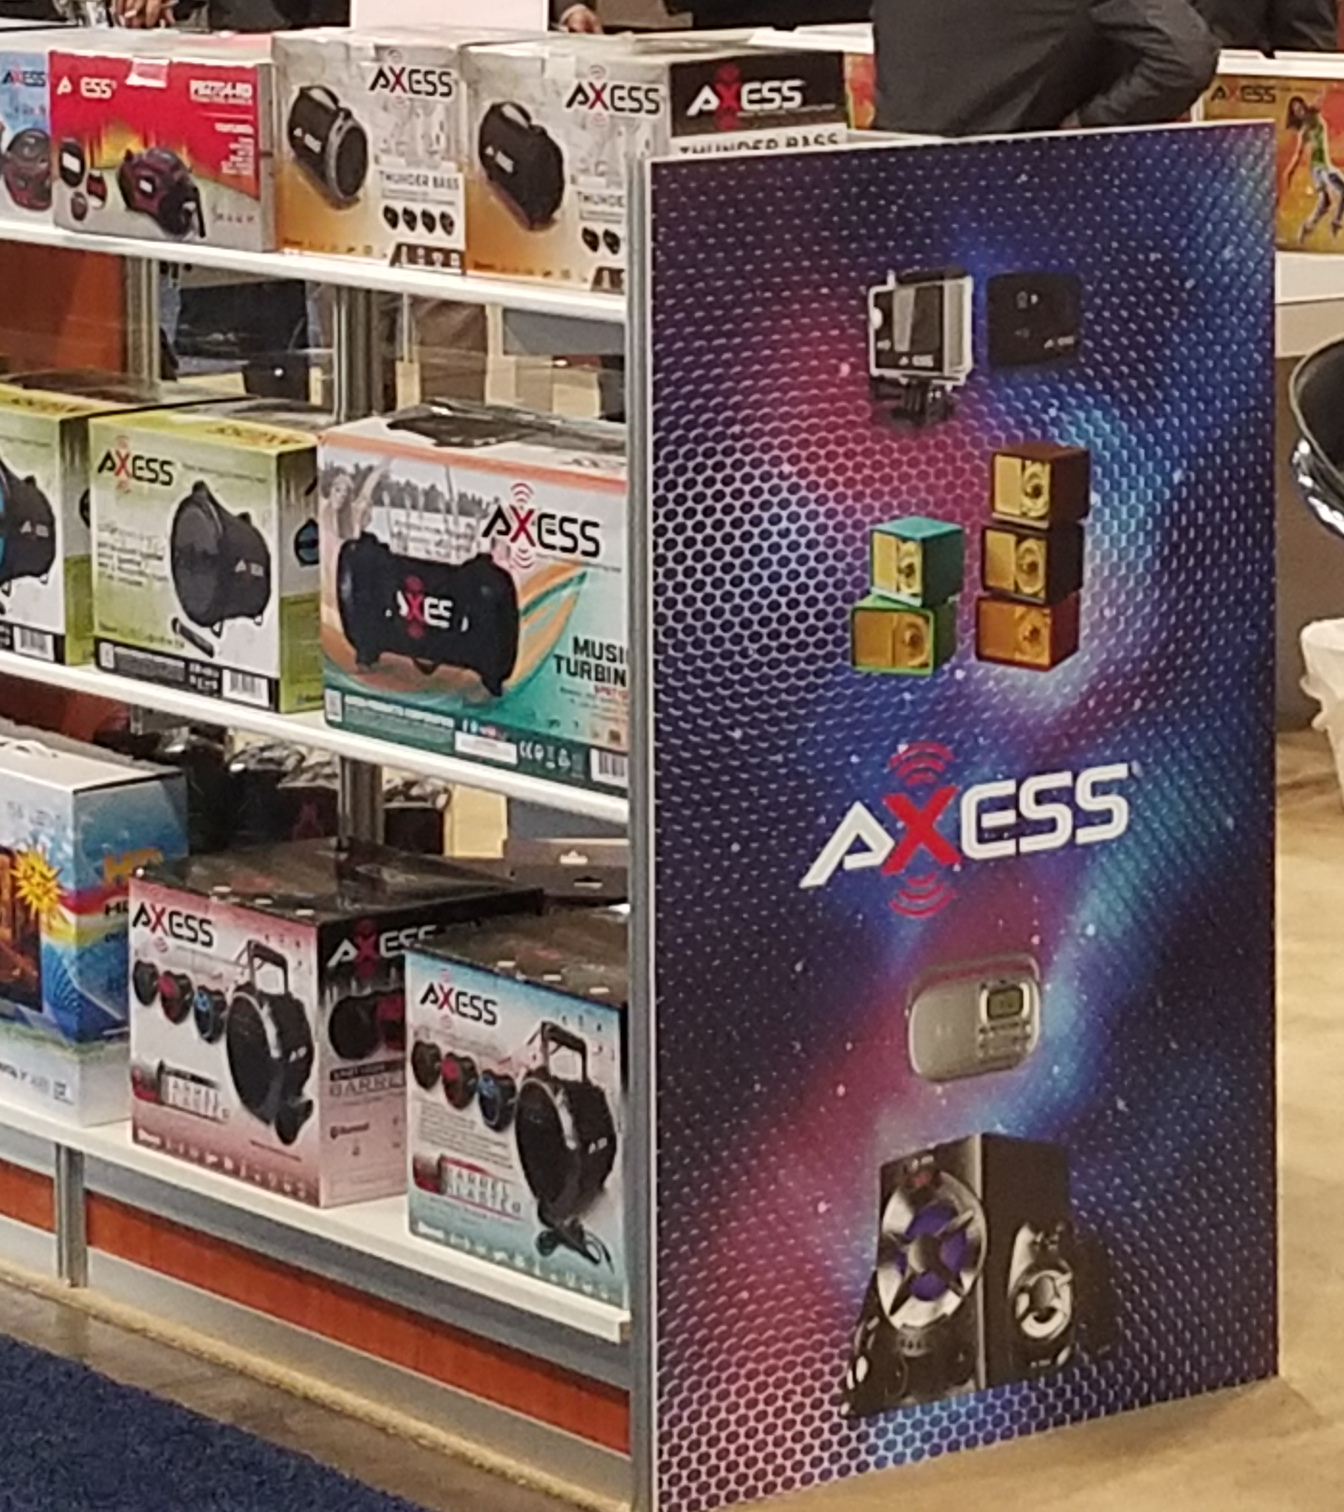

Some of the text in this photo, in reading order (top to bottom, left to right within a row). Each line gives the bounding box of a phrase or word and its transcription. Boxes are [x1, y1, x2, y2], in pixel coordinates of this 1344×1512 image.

[57, 76, 116, 99] AESS
[369, 66, 453, 98] AXESS
[565, 81, 660, 115] AXESS
[686, 79, 804, 118] AXESS
[1210, 84, 1277, 105] AXESS
[97, 450, 174, 486] AXESS
[482, 504, 601, 558] AXESS
[798, 762, 1130, 889] AXESS
[132, 902, 214, 948] AXESS
[419, 982, 498, 1026] AXESS
